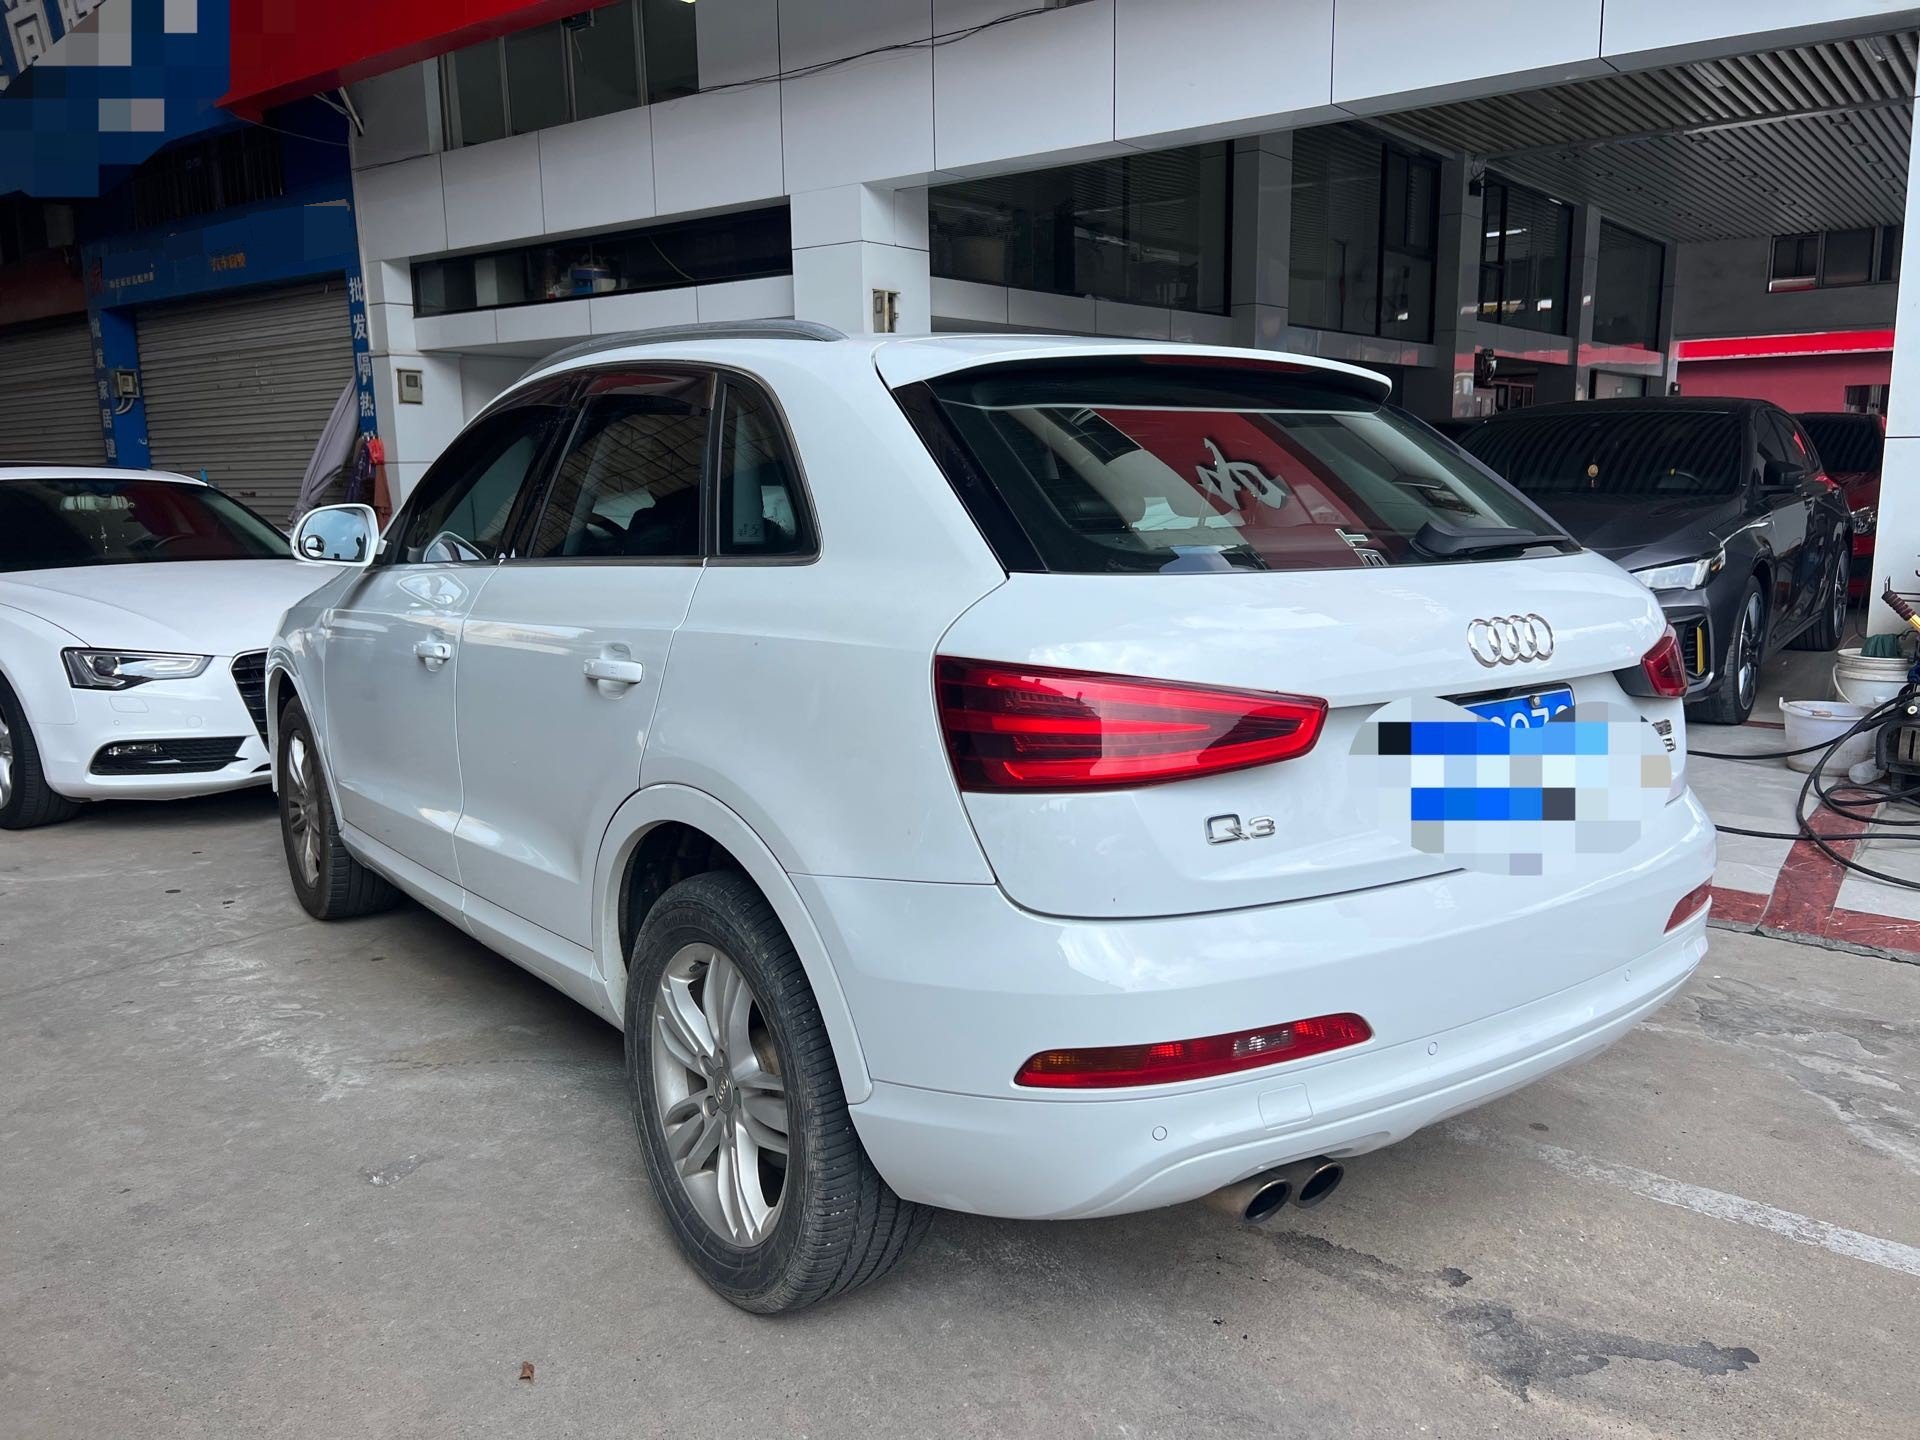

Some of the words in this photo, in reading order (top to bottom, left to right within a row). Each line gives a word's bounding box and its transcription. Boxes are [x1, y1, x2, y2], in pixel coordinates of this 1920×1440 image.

[348, 276, 376, 440] 批发隔热
[1204, 812, 1276, 846] Q3
